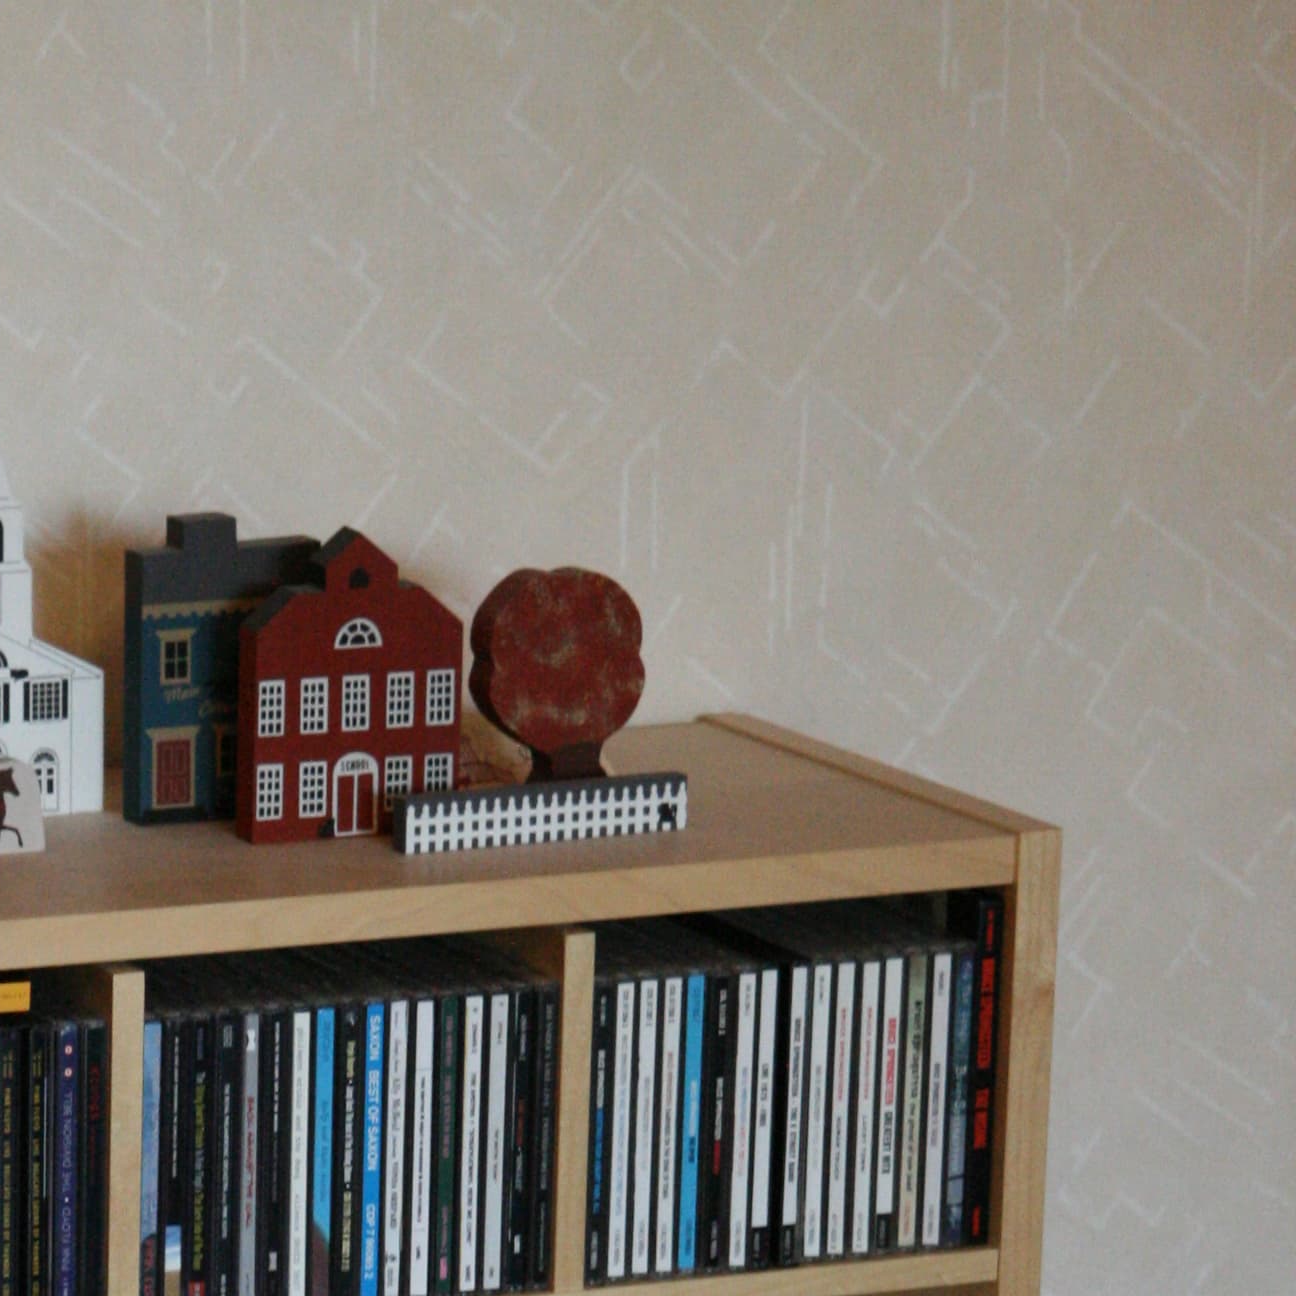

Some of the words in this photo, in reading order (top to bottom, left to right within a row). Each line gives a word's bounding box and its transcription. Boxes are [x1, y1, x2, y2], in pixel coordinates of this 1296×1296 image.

[369, 1015, 380, 1060] SAXON
[368, 1070, 379, 1102] BEST
[368, 1106, 379, 1123] OF
[881, 1111, 894, 1152] GREATEST
[367, 1126, 378, 1171] SAXON
[881, 1155, 893, 1174] HITS
